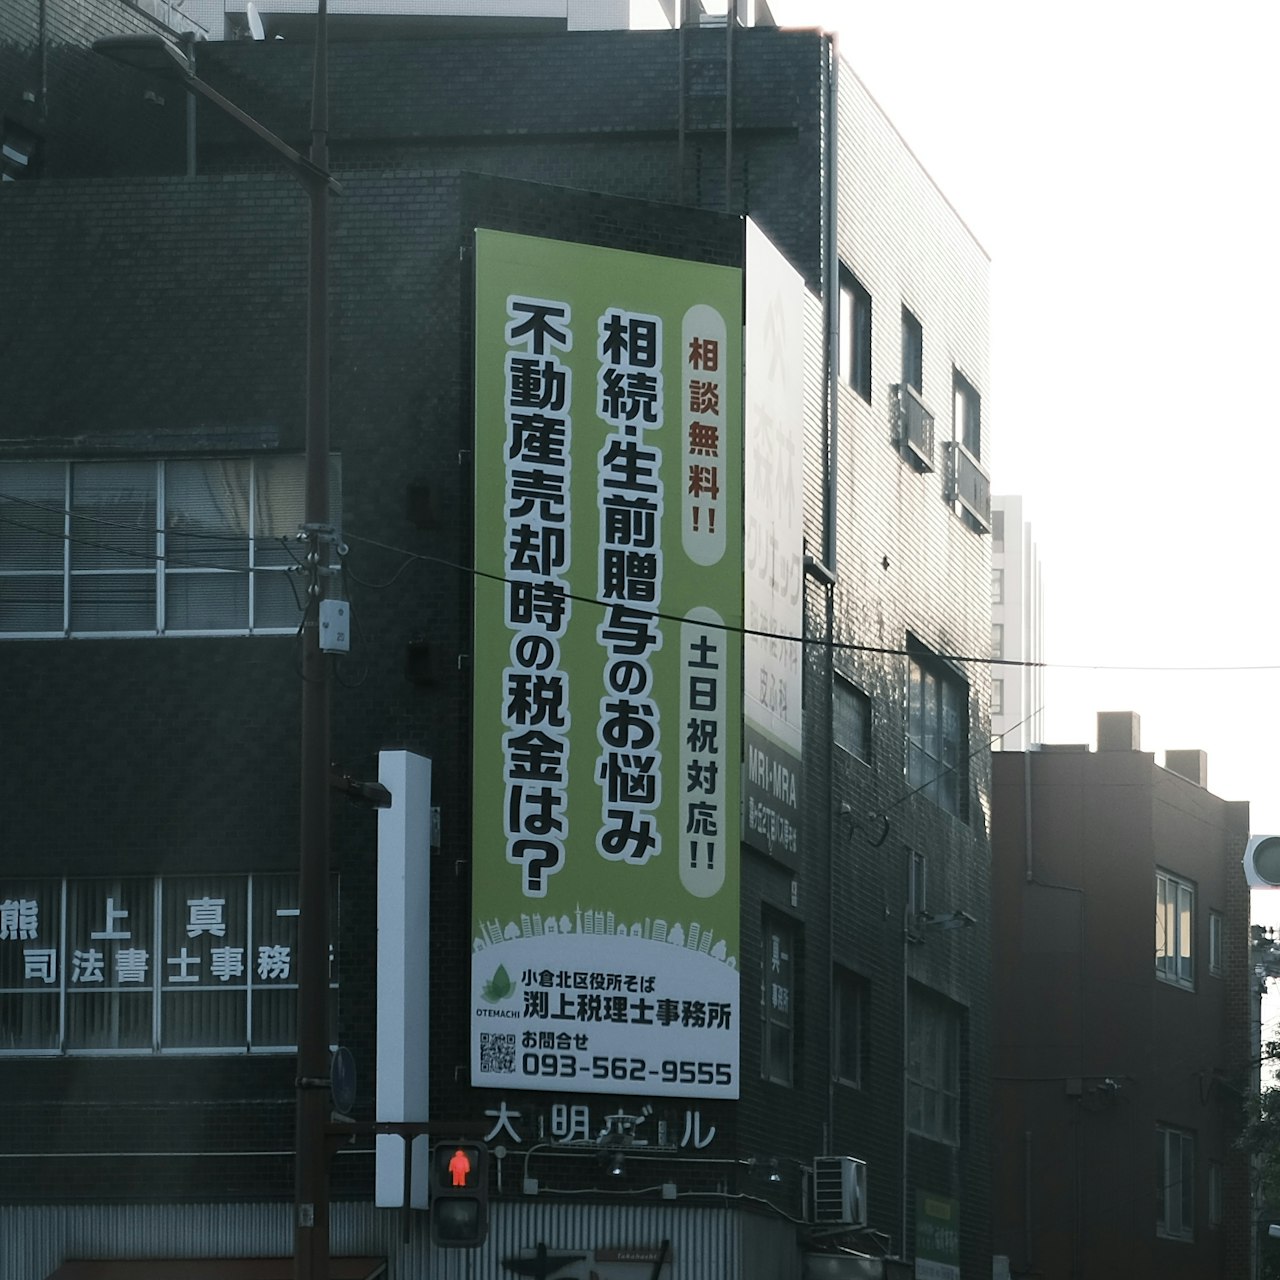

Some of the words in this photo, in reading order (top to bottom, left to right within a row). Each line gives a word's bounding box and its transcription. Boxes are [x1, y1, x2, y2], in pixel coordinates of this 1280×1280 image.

[600, 315, 660, 858] 相続・生前贈与のお悩み
[22, 944, 335, 984] 司法書士事務
[521, 969, 656, 993] 小倉北区役所そば
[476, 1008, 520, 1019] OTEMACHI
[521, 1030, 588, 1050] お問合せ
[522, 1053, 732, 1085] 093-562-9555
